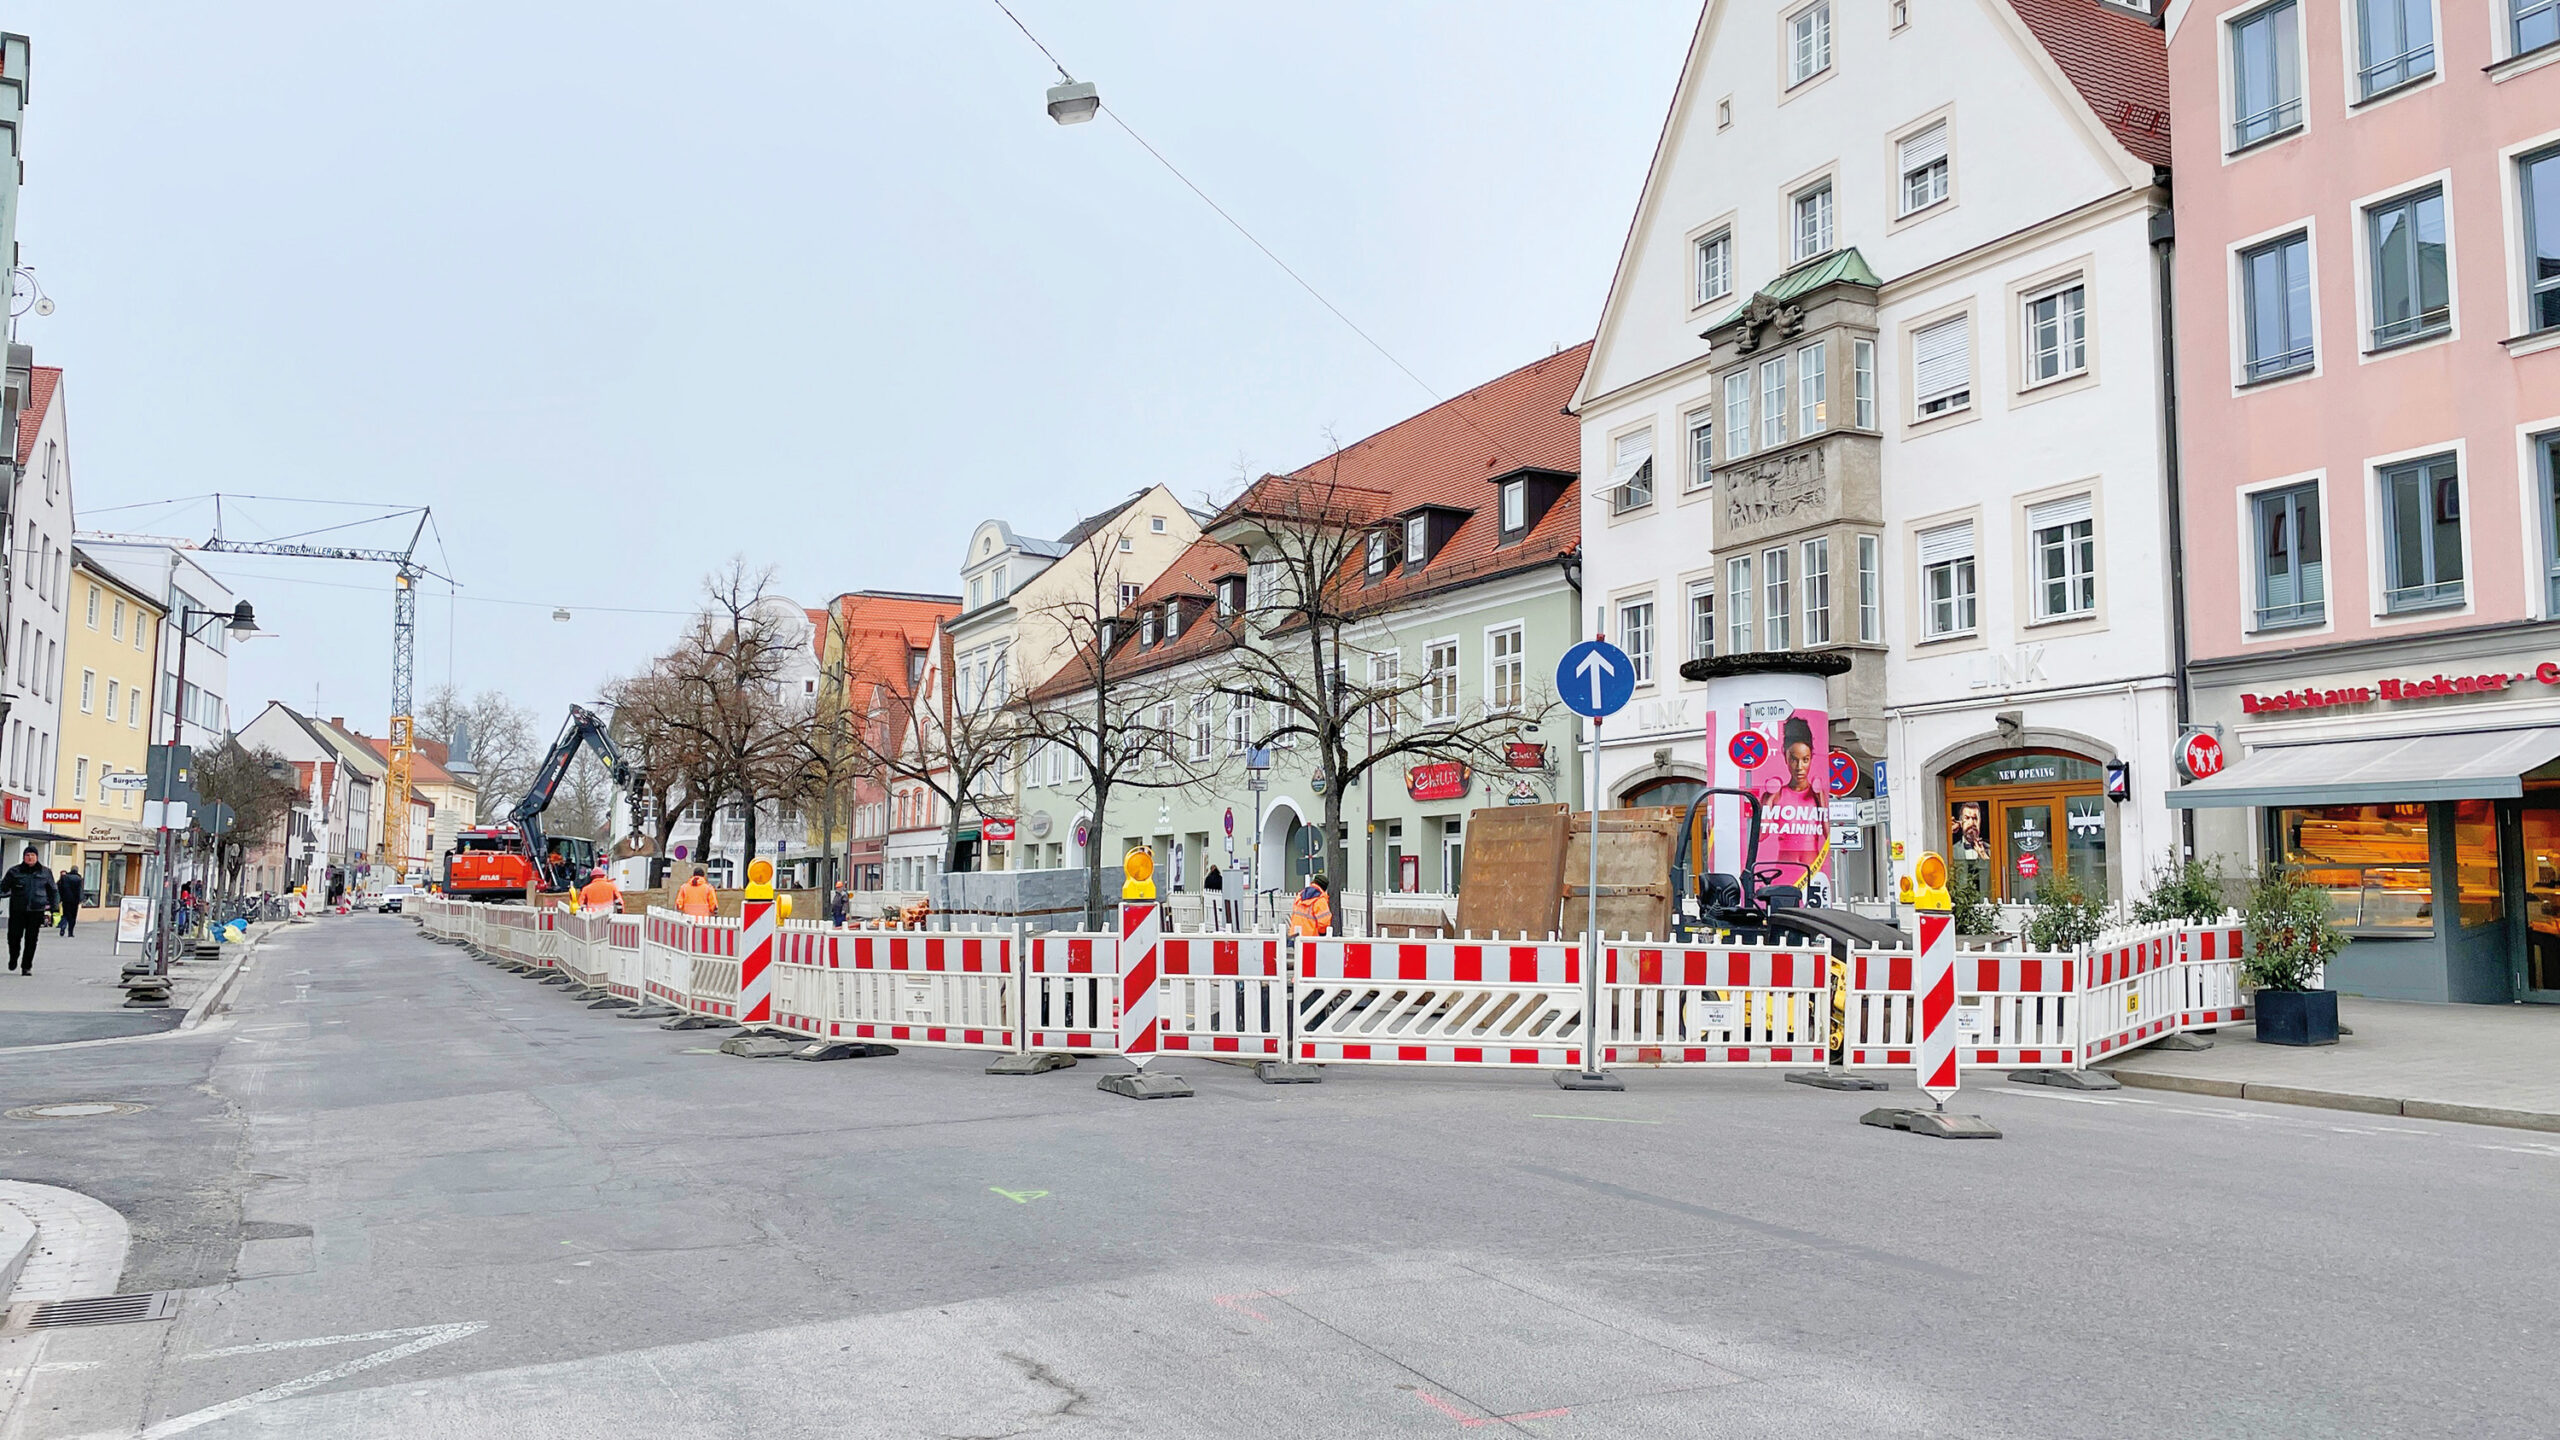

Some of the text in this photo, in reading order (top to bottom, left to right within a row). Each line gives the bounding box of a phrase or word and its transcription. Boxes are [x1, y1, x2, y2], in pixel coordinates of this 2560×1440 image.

[1969, 646, 2047, 689] LINK
[2240, 687, 2375, 714] Backhaus
[2378, 673, 2510, 701] Hackner
[1639, 698, 1689, 730] LINK
[1754, 705, 1766, 717] WC
[1767, 704, 1778, 716] 100
[1415, 770, 1461, 791] Chilli's
[1999, 767, 2055, 781] NEW OPENING
[45, 812, 79, 820] NORMA
[1760, 805, 1829, 823] MONATE
[1760, 822, 1823, 836] TRAINING
